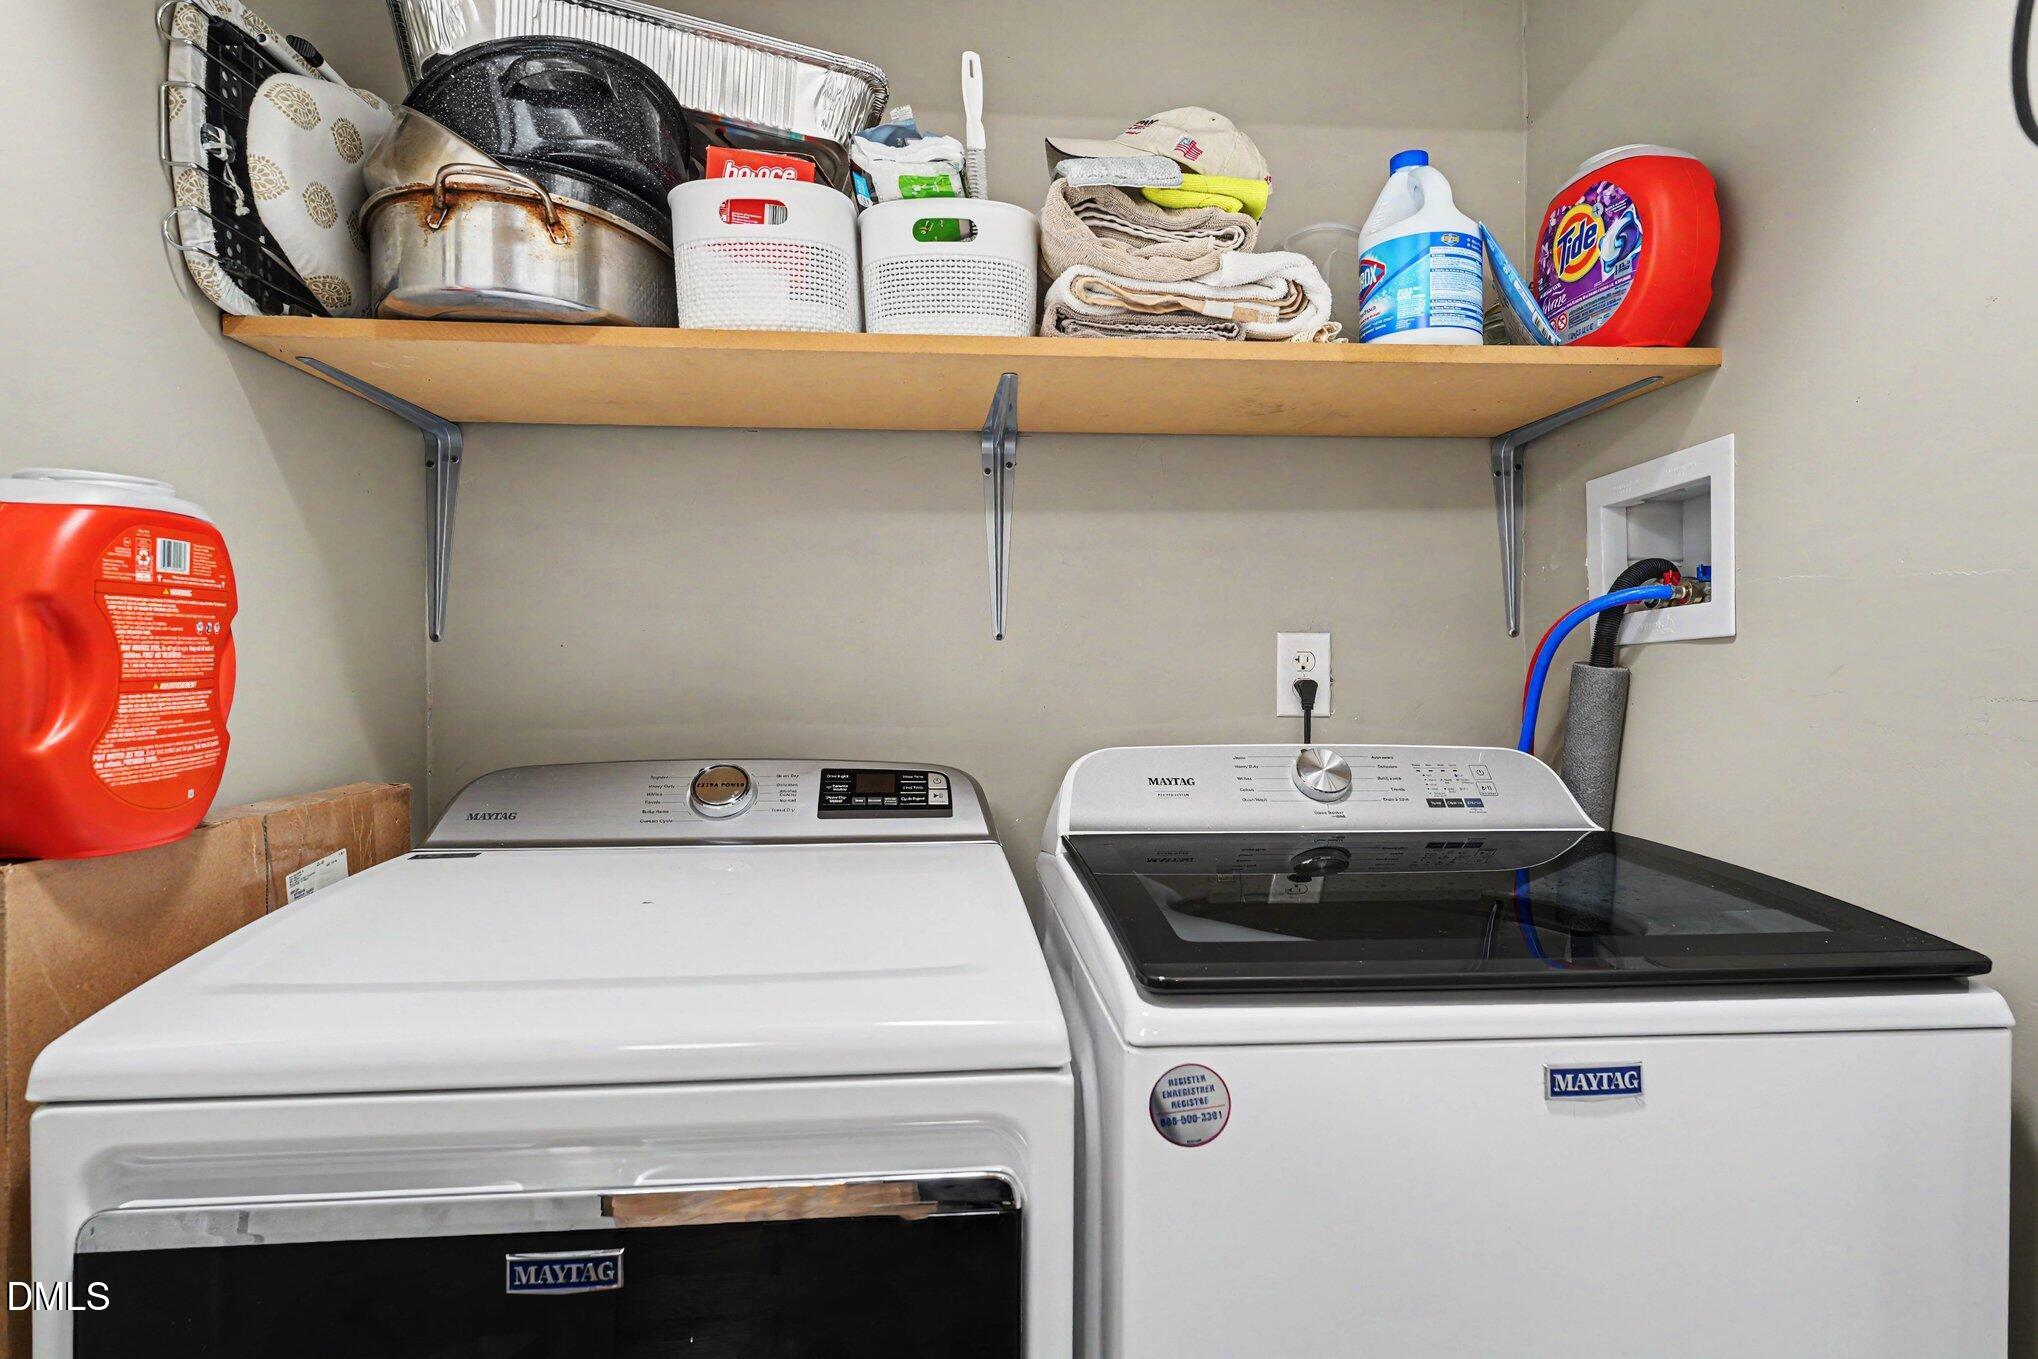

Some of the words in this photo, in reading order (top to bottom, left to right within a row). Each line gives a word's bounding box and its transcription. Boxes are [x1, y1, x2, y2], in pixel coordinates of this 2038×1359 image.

[1558, 217, 1598, 276] Tide
[1148, 777, 1196, 786] MAYTAG
[466, 812, 518, 821] MAYTAG
[1168, 1074, 1206, 1087] REGISTER
[1553, 1071, 1640, 1092] MAYTAG
[1162, 1084, 1216, 1100] ENREGISTRER
[1171, 1097, 1210, 1109] REGISTRE
[513, 1261, 615, 1286] MAYTAG
